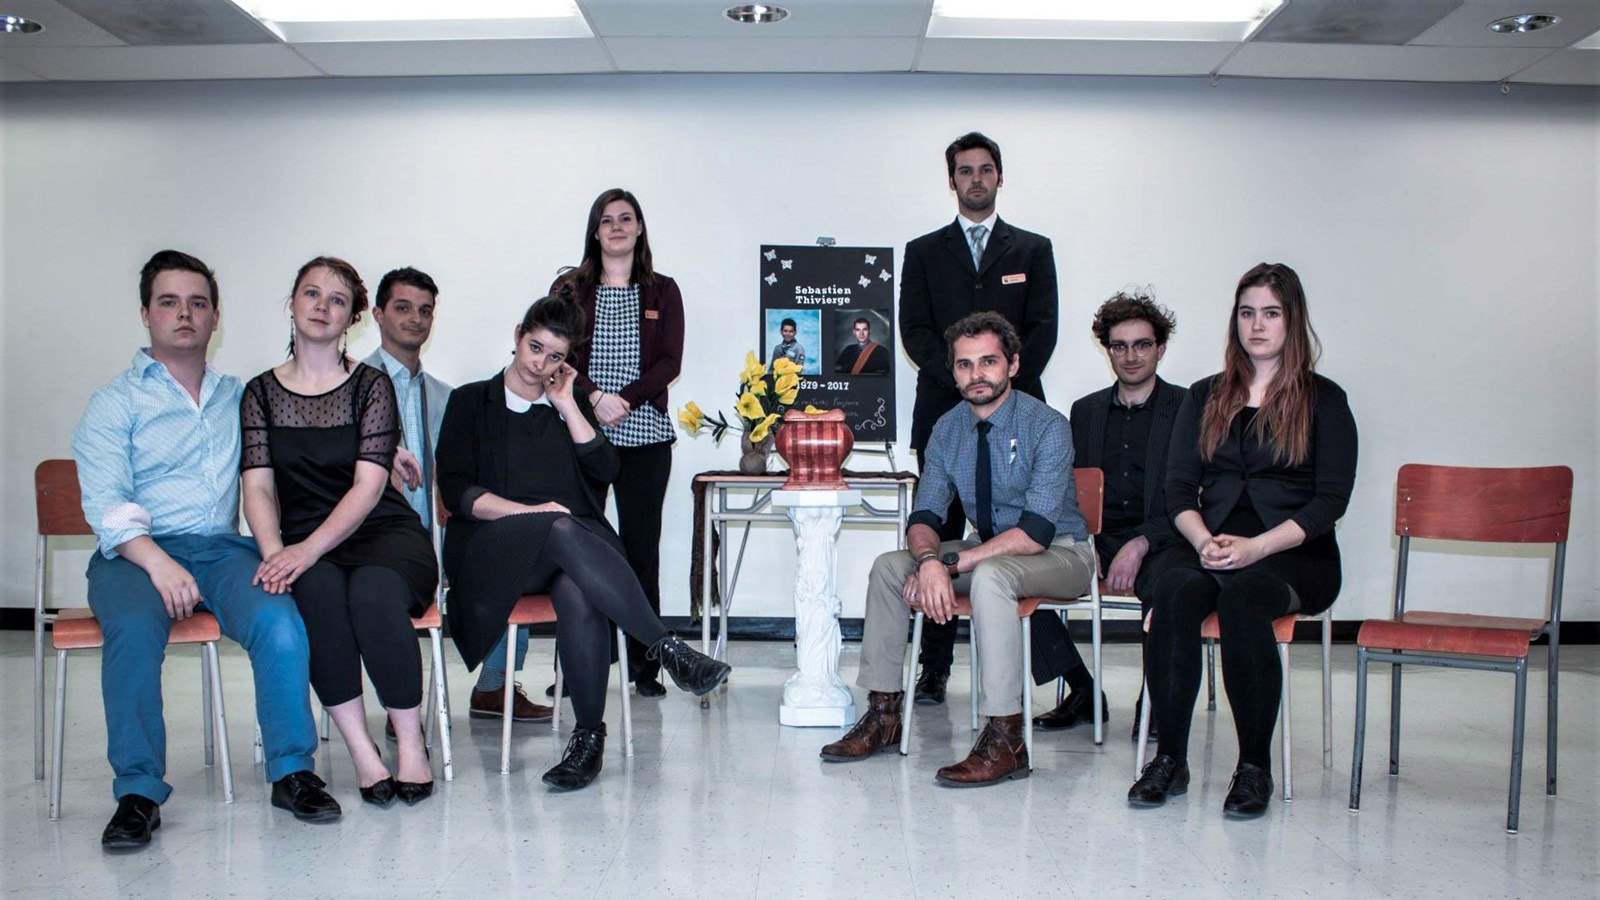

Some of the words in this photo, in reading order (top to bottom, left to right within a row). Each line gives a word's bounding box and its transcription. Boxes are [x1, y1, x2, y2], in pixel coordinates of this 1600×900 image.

[795, 284, 851, 294] Sebastien
[795, 295, 851, 306] Thivierge
[827, 381, 850, 391] 2017
